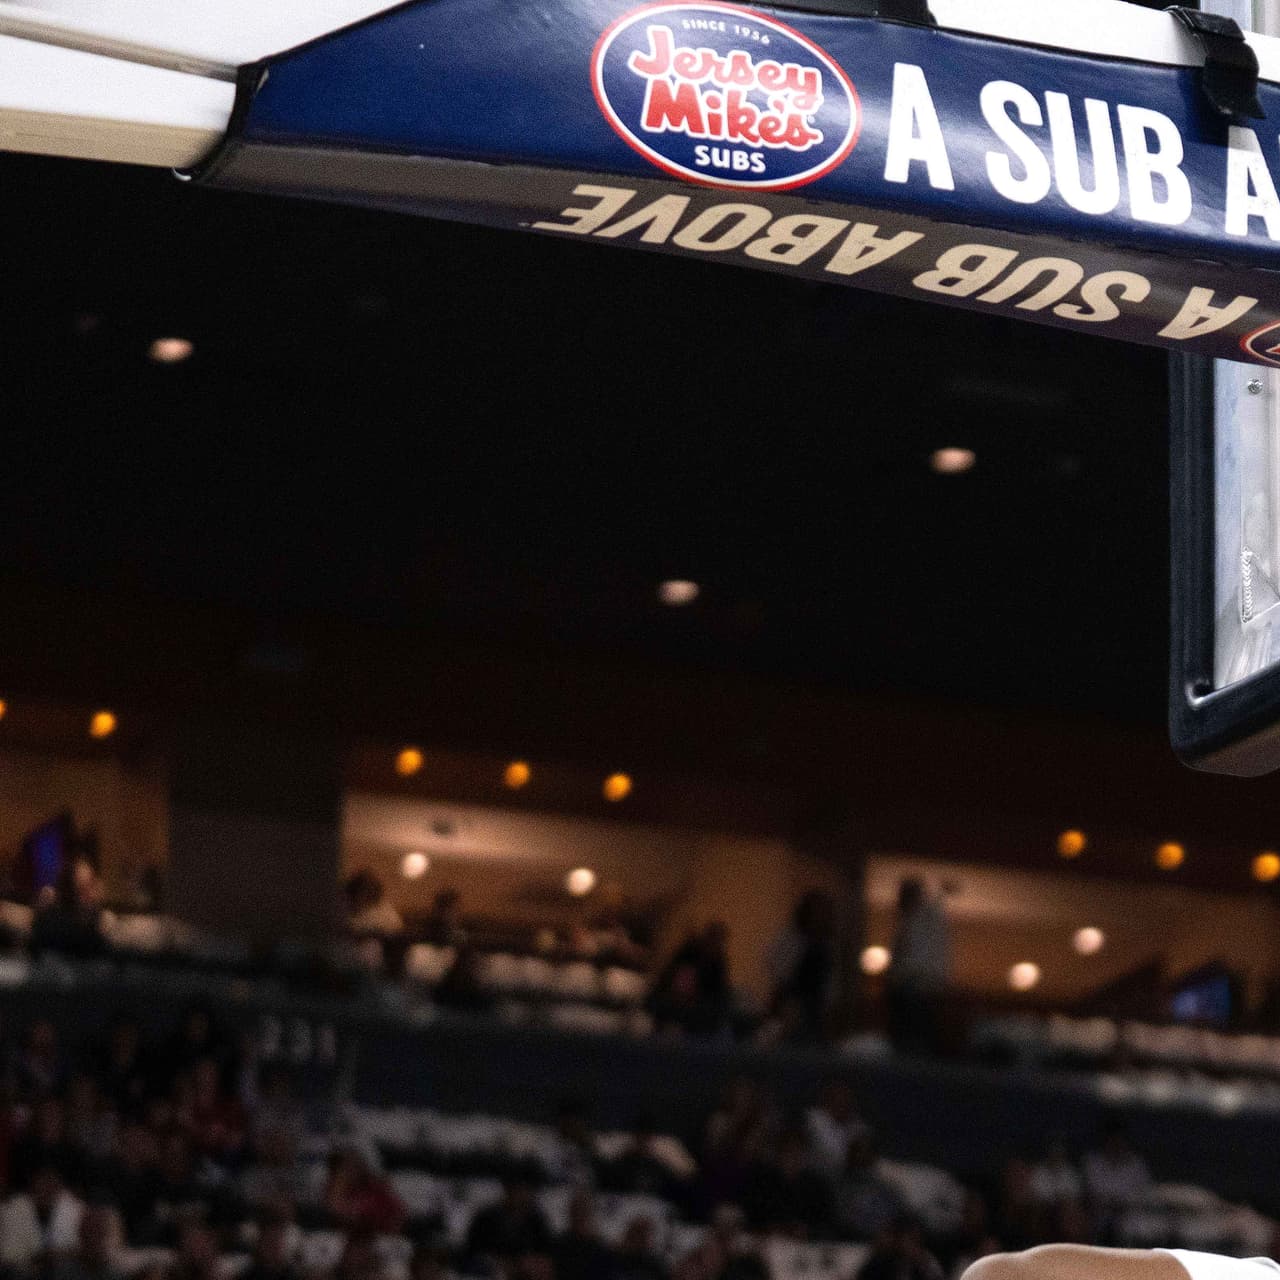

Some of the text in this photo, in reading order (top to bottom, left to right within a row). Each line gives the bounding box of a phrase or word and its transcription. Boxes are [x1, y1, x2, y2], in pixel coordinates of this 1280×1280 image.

[630, 25, 822, 114] Jersey
[682, 18, 770, 45] SINCE 1956
[643, 77, 823, 149] Mike's
[884, 62, 955, 191] A
[979, 80, 1193, 225] SUB
[694, 145, 766, 173] SUBS
[531, 184, 1259, 340] A SUB ABOVE
